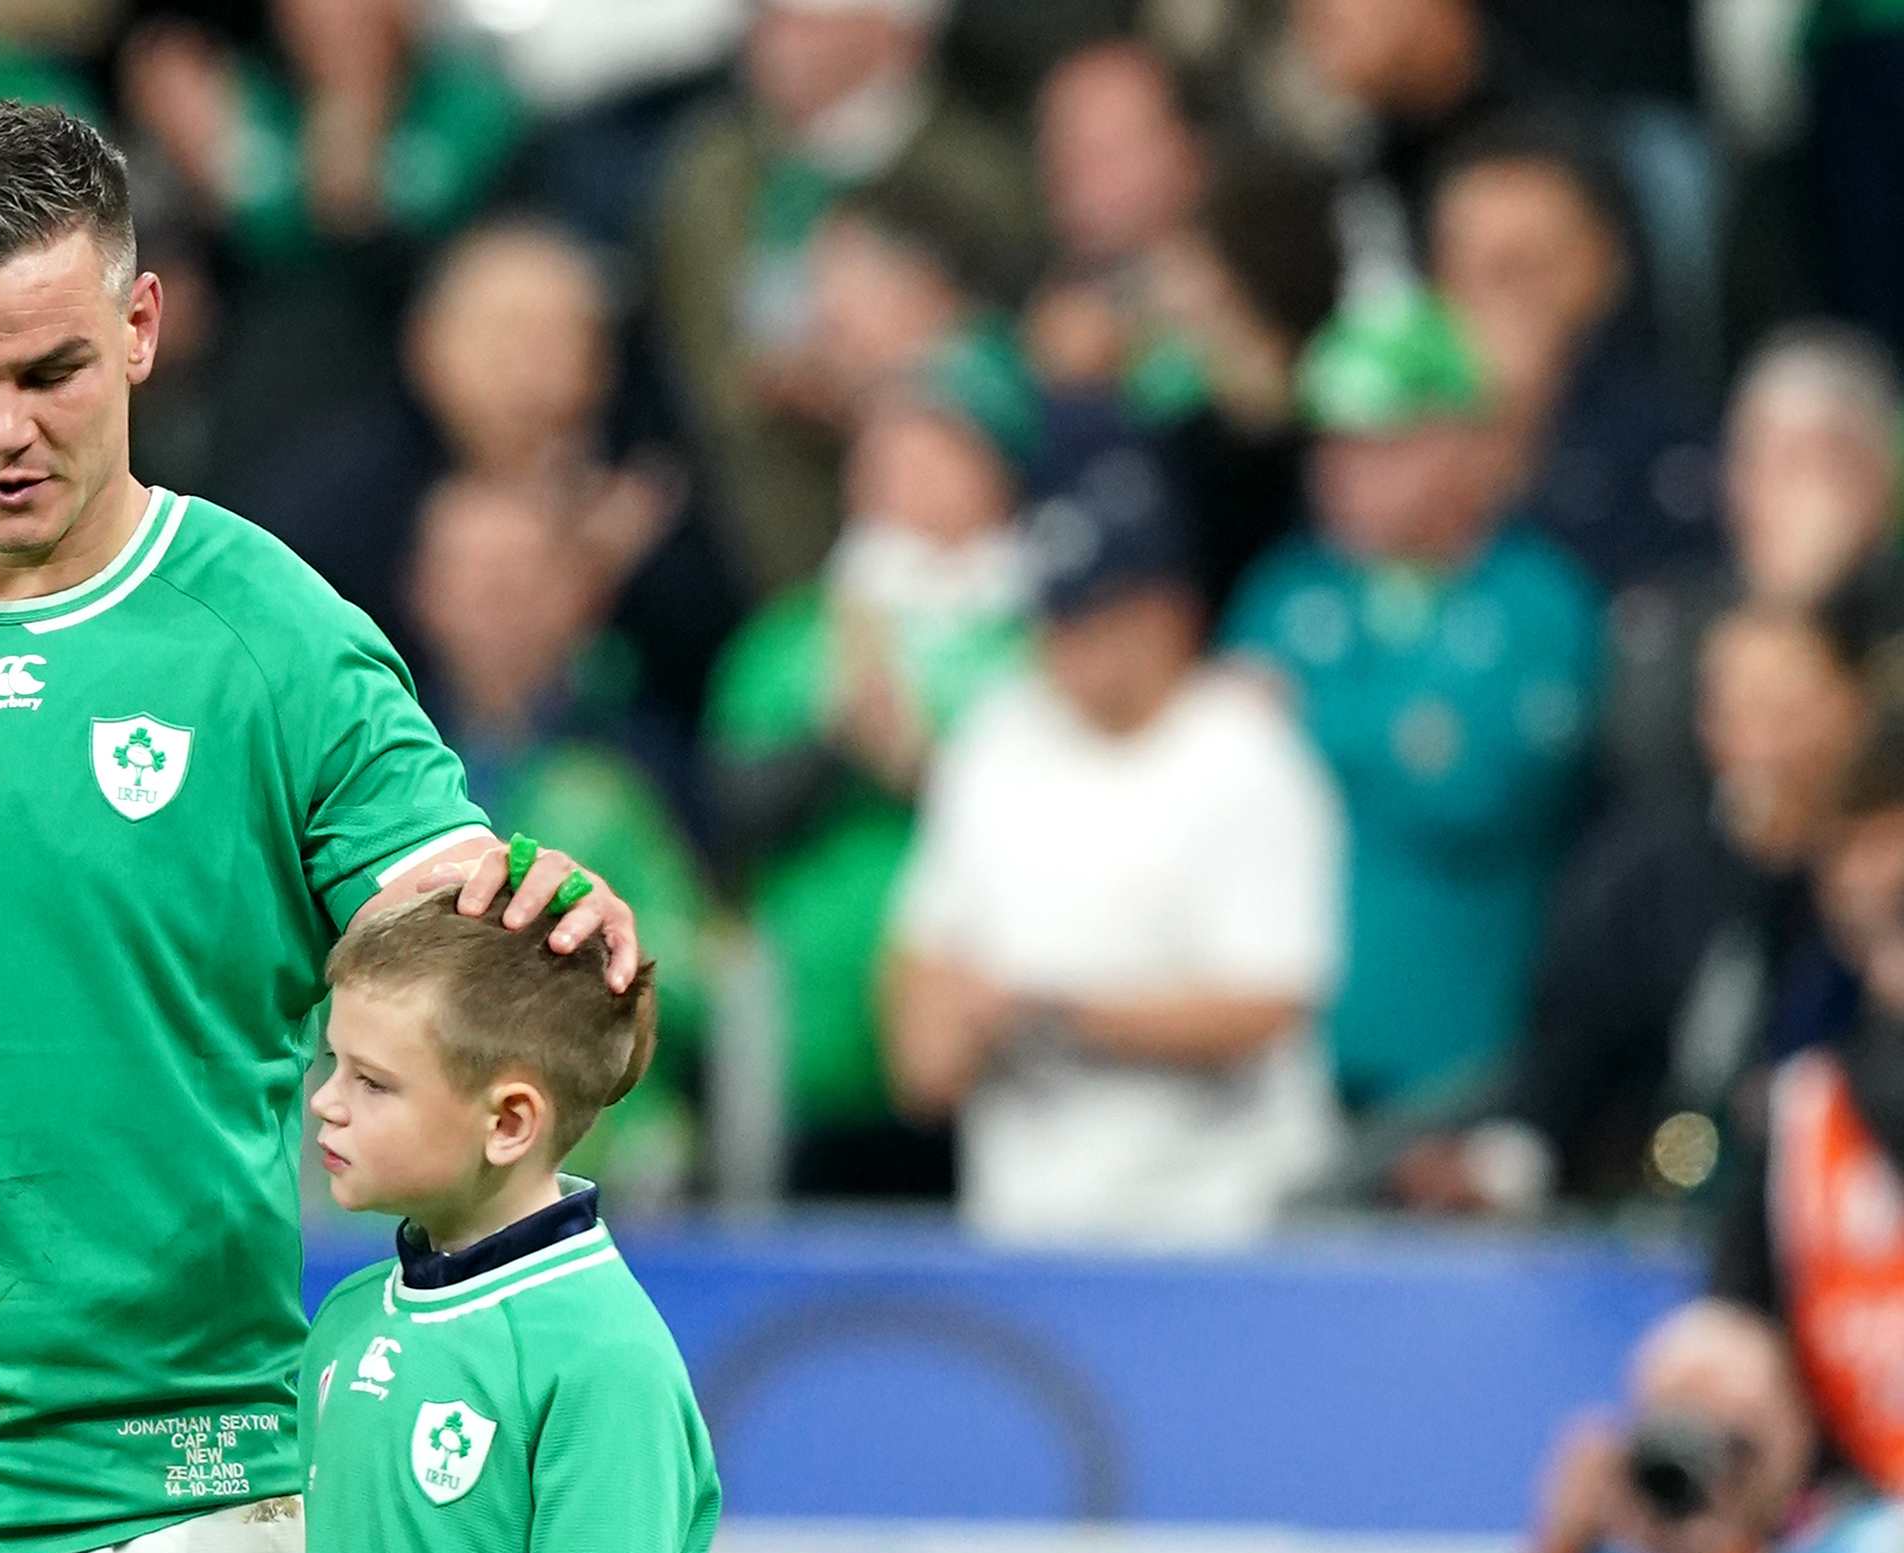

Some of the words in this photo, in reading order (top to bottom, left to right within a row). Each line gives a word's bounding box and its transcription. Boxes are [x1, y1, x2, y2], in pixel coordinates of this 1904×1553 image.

[117, 785, 158, 805] IRFU
[117, 1415, 211, 1435] JONATHAN
[219, 1414, 279, 1431] SEXTON
[171, 1434, 206, 1448] CAP
[216, 1432, 237, 1447] 118
[186, 1448, 222, 1465] NEW
[167, 1463, 244, 1480] ZEALAND
[425, 1467, 461, 1490] IRFU
[164, 1480, 250, 1496] 14-10-2023
